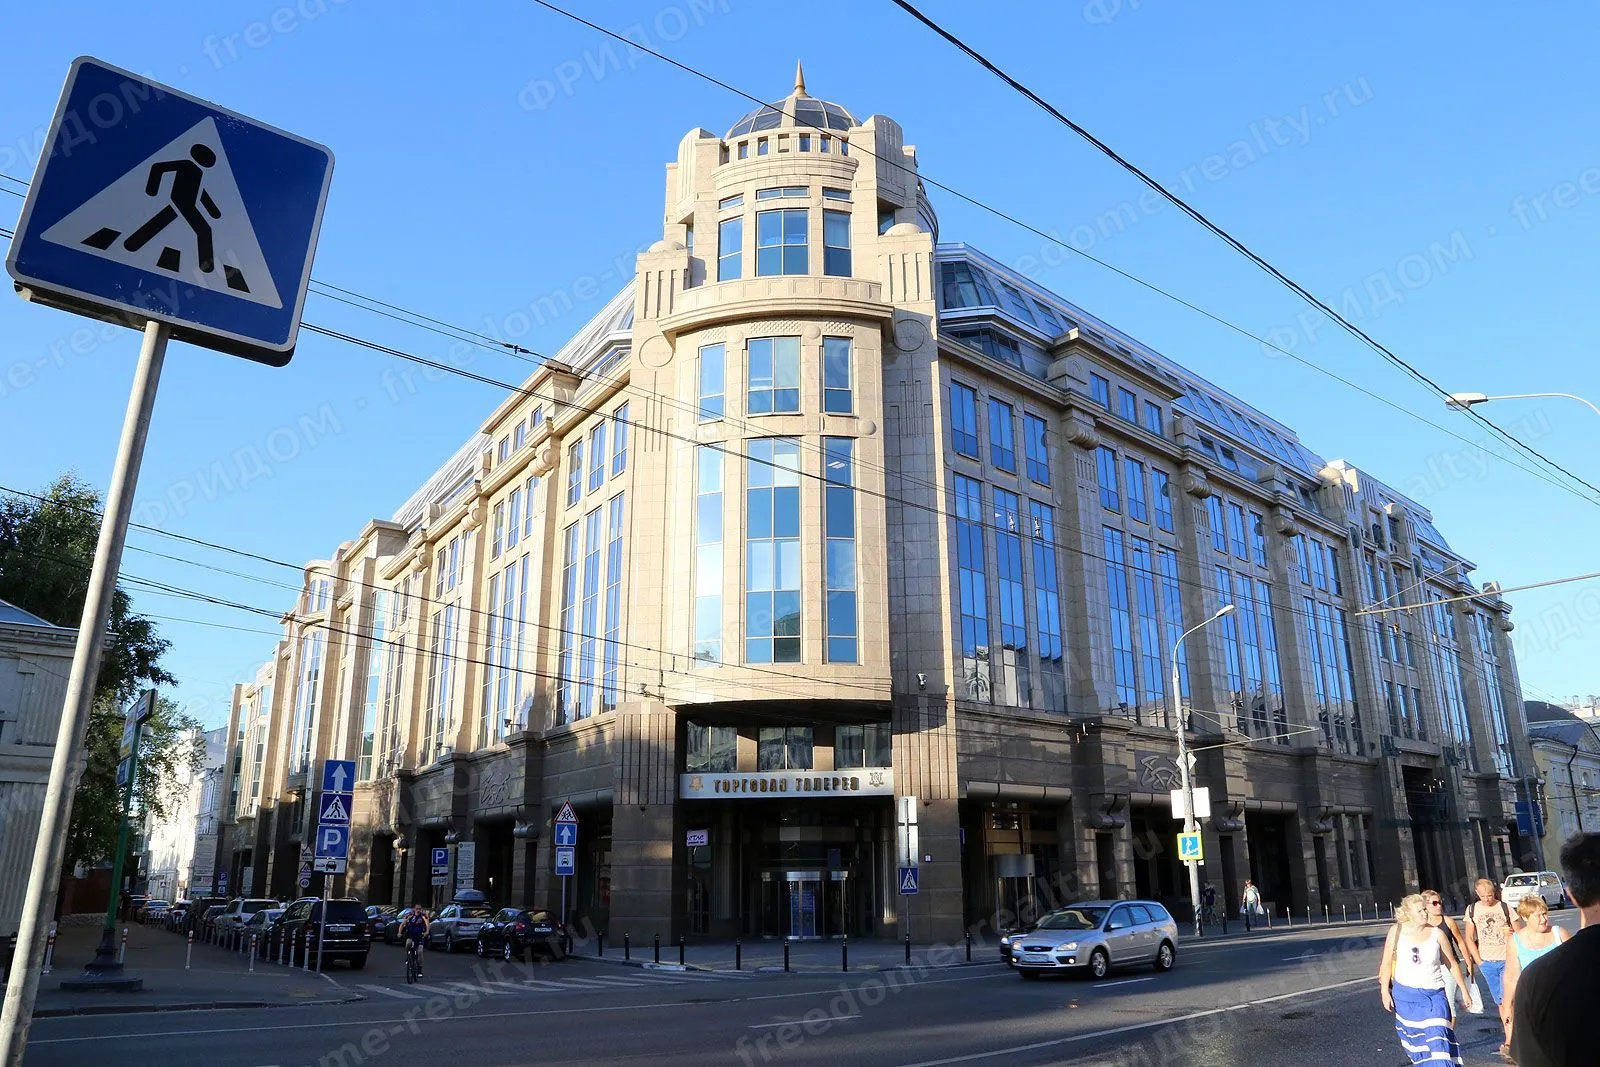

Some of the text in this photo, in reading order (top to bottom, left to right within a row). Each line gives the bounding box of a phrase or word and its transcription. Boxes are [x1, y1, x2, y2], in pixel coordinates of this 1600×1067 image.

[713, 776, 860, 794] ТОРГОВАЯ ГАЛЕРЕЯ
[323, 829, 342, 851] P
[435, 850, 445, 864] P
